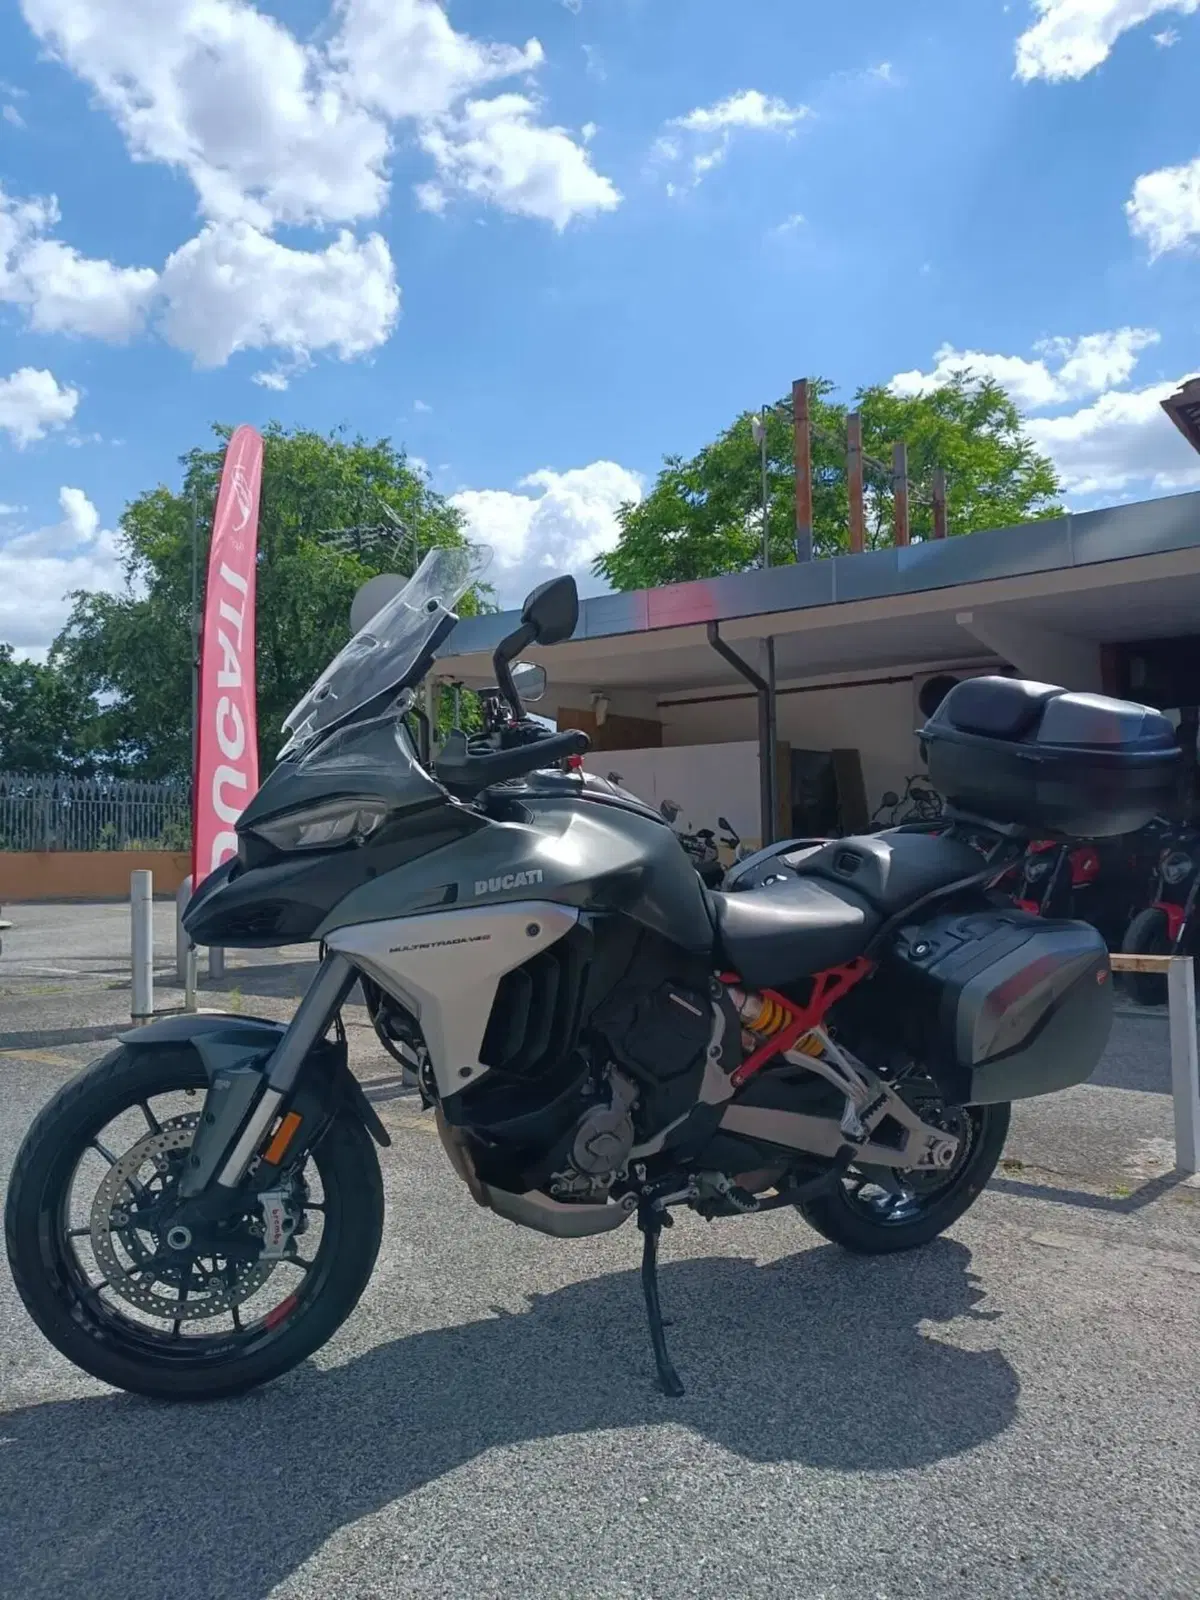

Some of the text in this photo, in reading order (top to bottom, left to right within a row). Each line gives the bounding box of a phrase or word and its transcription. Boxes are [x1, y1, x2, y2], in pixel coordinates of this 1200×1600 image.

[475, 869, 543, 896] DUCATI
[389, 937, 468, 954] MULTISTRADA
[272, 1208, 282, 1245] brembo
